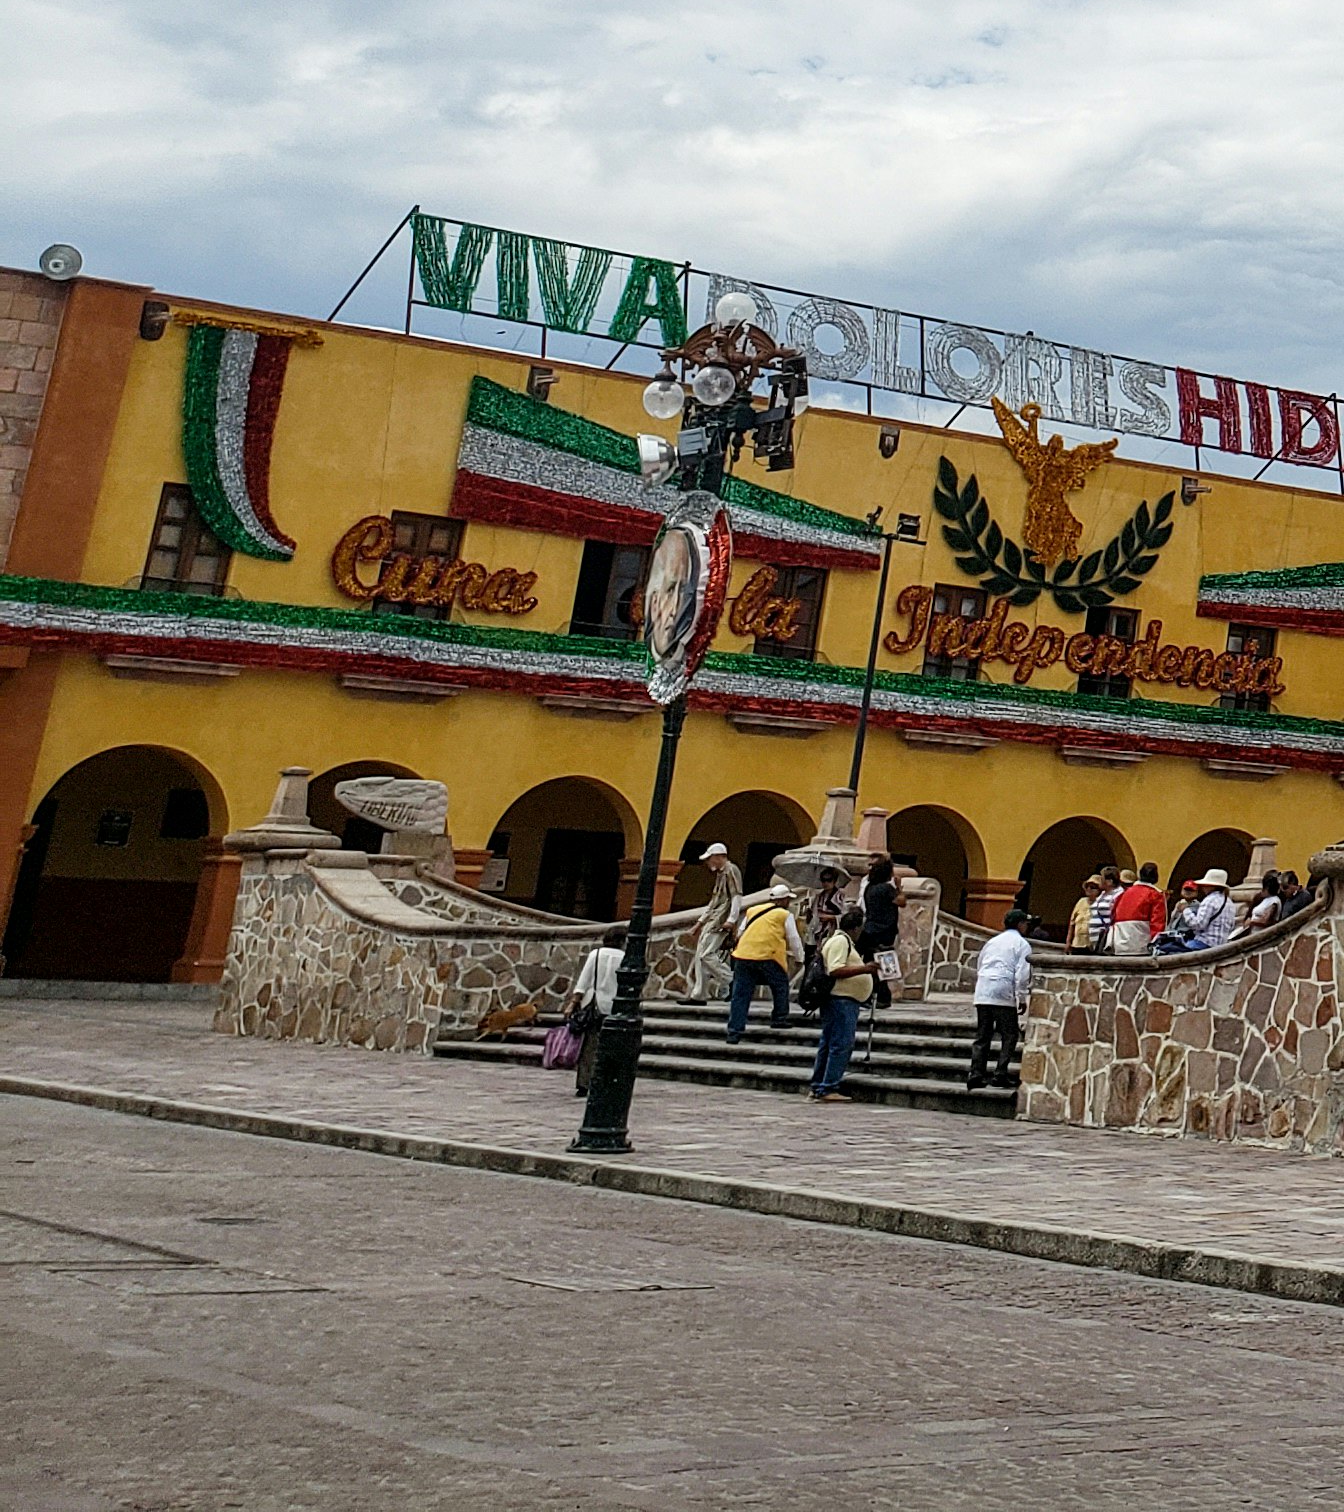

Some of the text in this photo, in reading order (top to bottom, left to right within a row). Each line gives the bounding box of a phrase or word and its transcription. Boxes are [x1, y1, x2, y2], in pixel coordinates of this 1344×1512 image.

[411, 213, 688, 348] VIVA
[331, 514, 539, 615] Cuna
[729, 564, 801, 643] la
[884, 584, 1287, 696] Independencia
